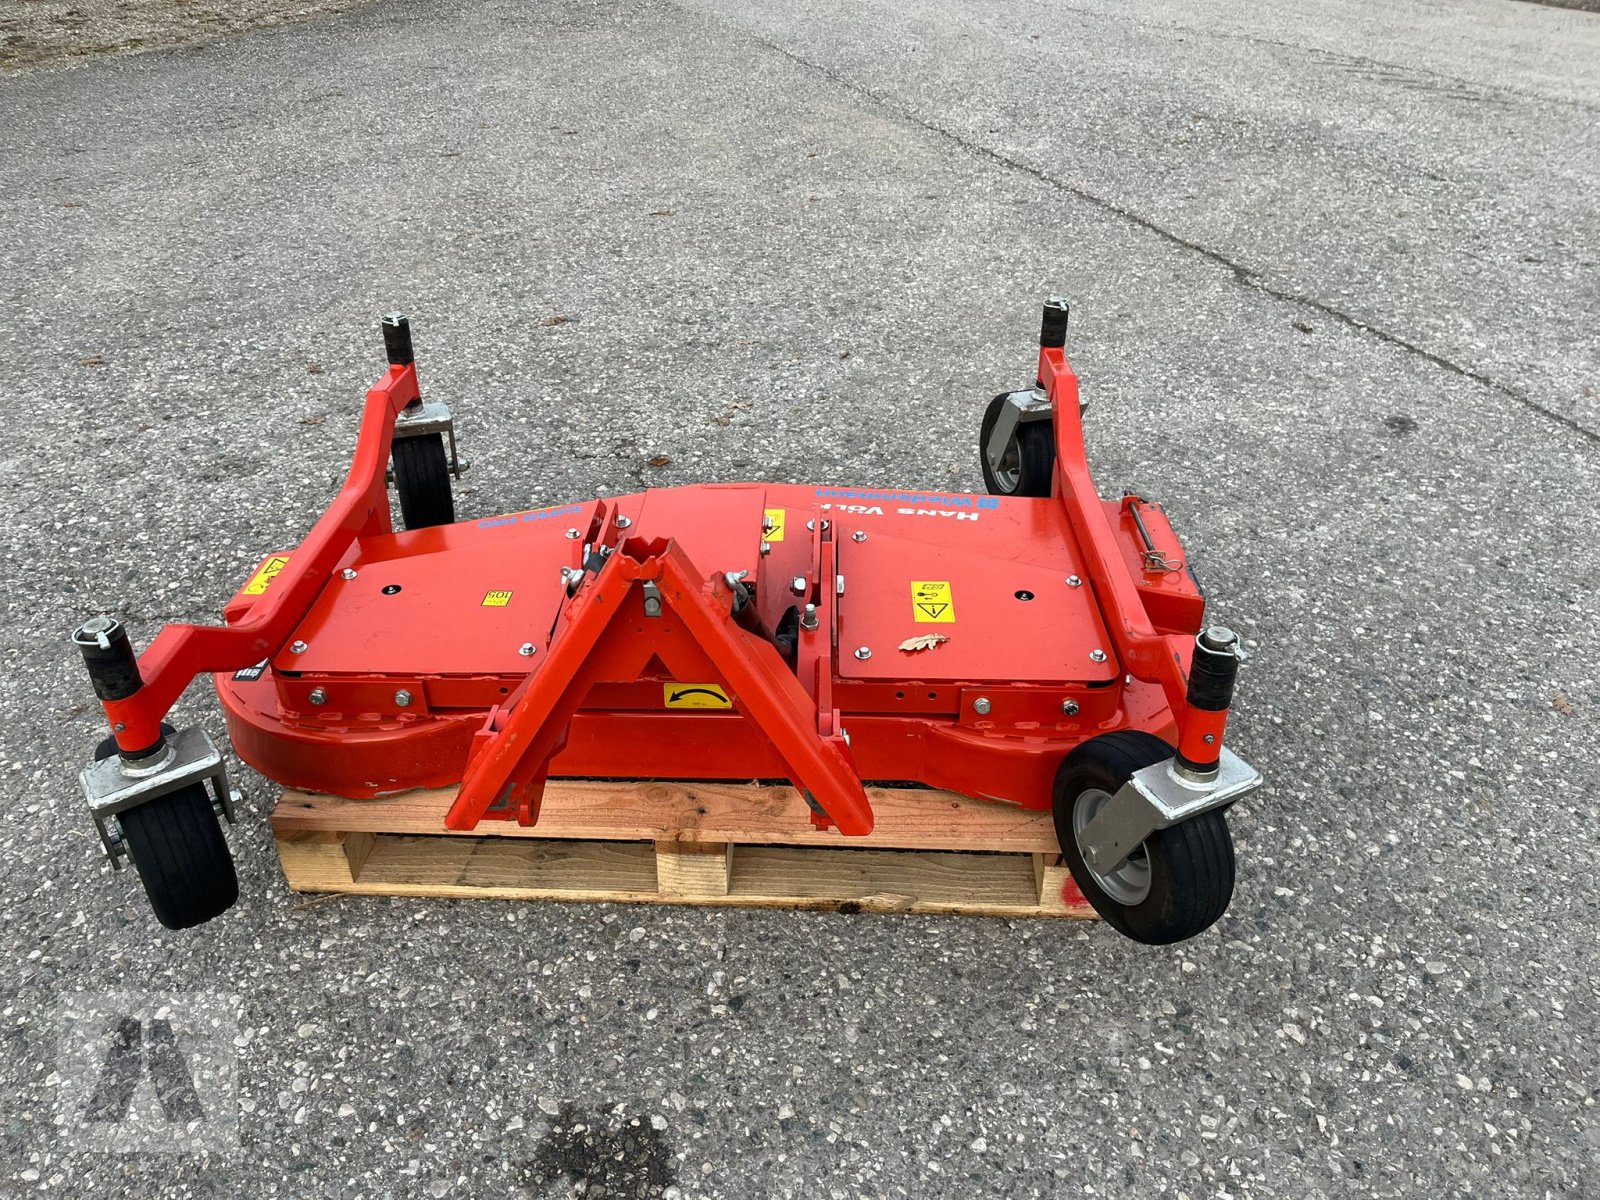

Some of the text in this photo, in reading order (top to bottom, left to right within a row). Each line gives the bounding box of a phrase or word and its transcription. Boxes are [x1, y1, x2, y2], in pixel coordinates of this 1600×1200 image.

[816, 489, 972, 507] Wiedenmann
[479, 505, 582, 528] SUPER PRO
[897, 508, 980, 521] HANS
[488, 591, 509, 599] 105
